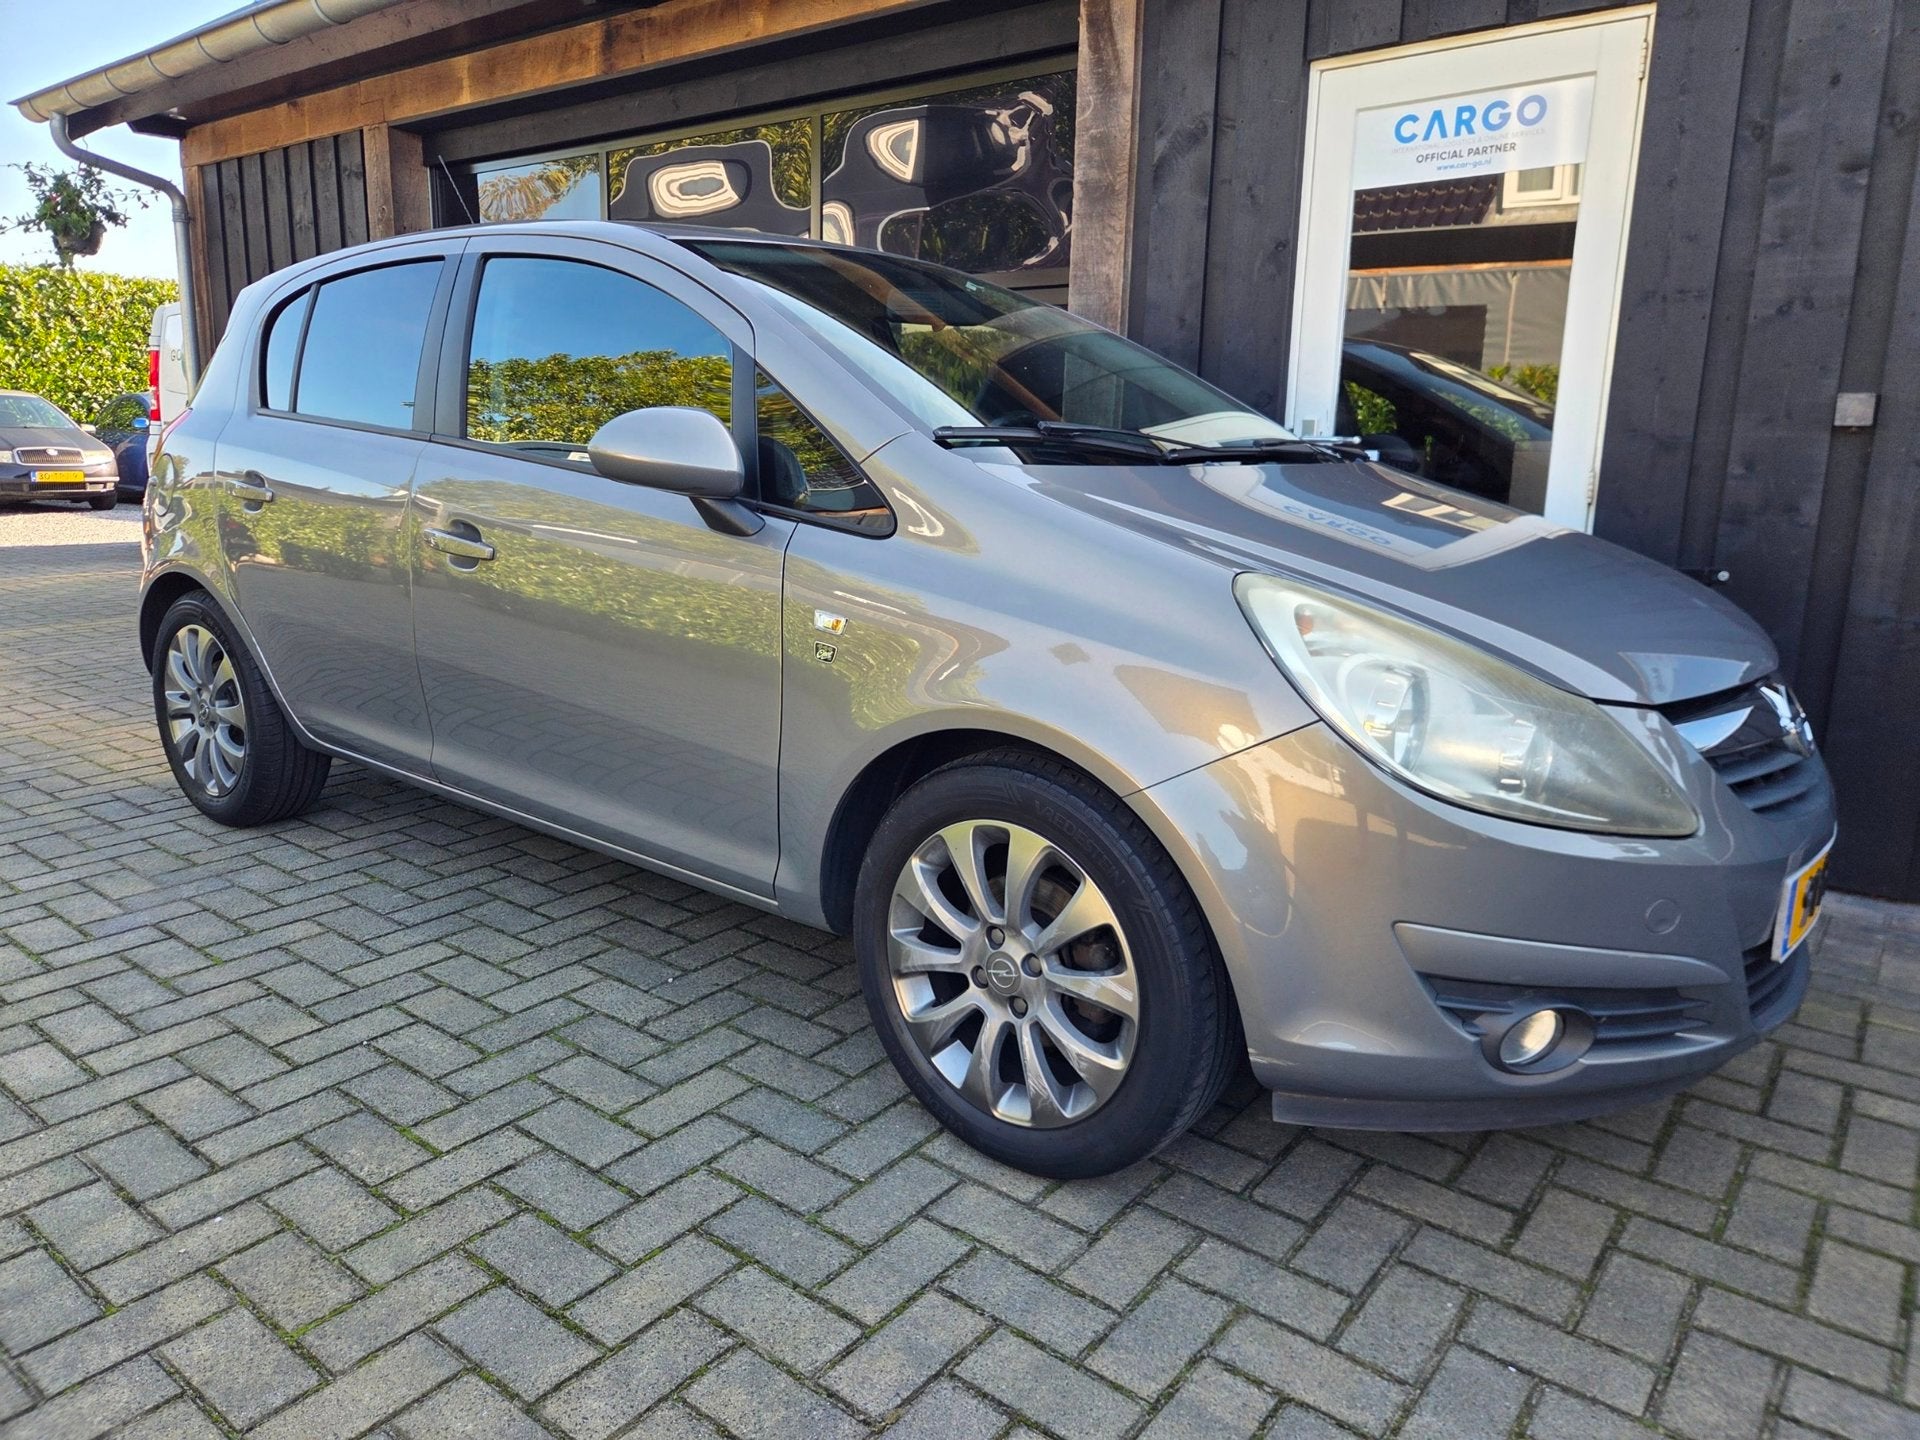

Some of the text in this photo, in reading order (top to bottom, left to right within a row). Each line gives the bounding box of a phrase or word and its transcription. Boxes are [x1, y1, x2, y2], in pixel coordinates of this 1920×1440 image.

[1395, 94, 1548, 144] CARGO
[1416, 142, 1517, 164] OFFICIAL PARTNER
